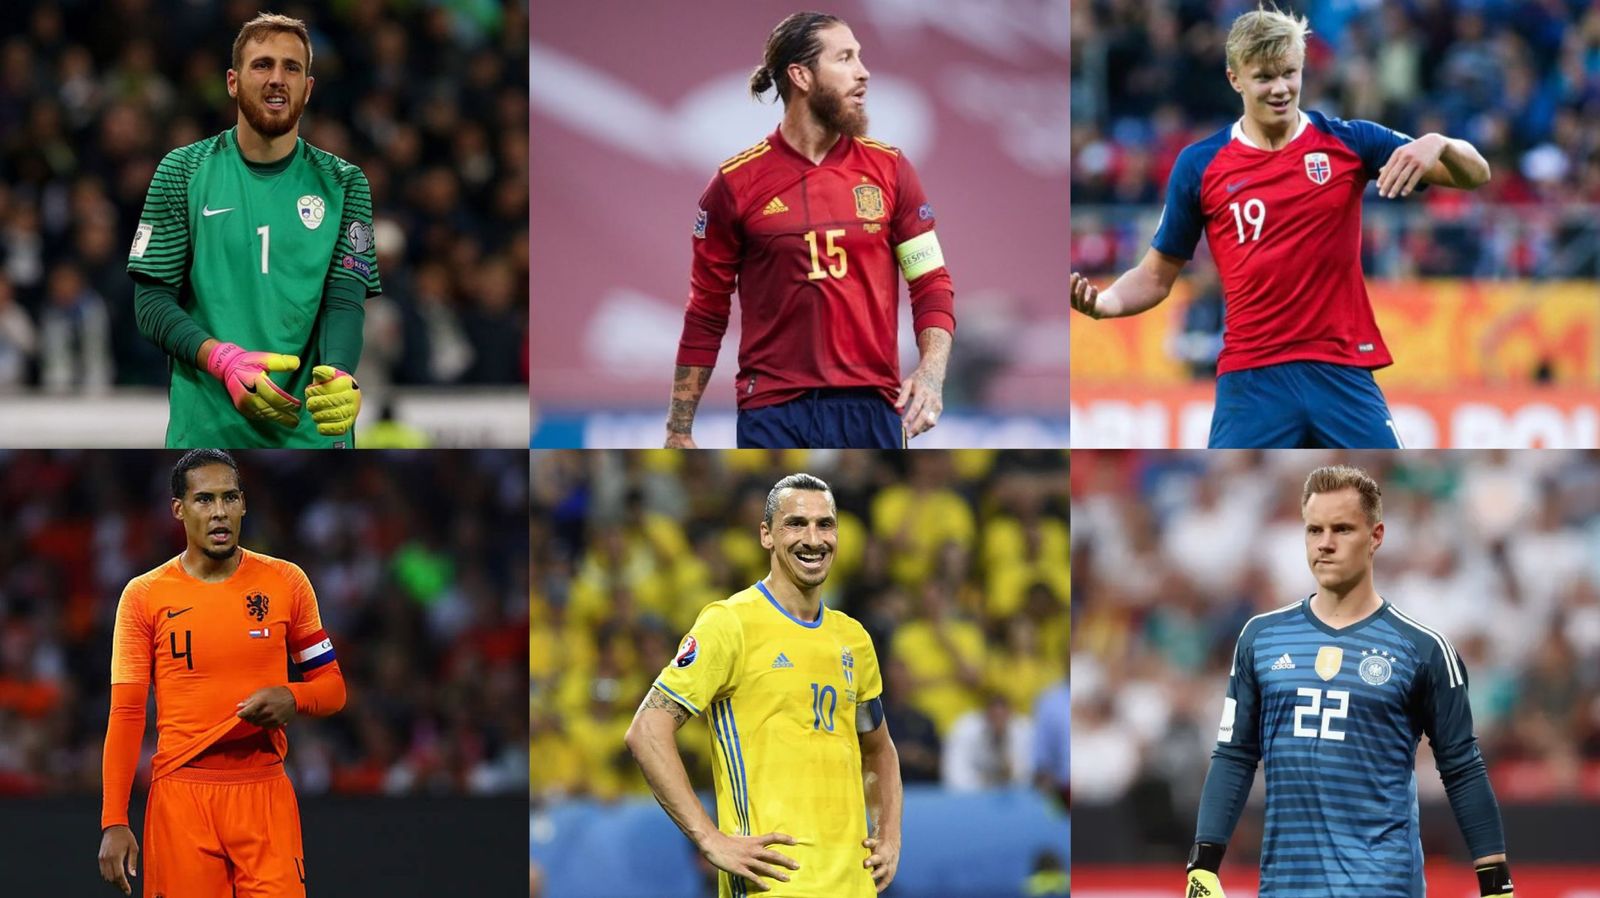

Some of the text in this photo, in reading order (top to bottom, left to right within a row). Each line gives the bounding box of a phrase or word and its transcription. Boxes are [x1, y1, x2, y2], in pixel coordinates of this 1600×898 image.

[1229, 198, 1267, 245] 19
[256, 224, 270, 275] 1
[804, 229, 848, 281] 15
[170, 630, 193, 671] 4
[1271, 663, 1296, 672] adidas
[810, 683, 837, 732] 10
[1294, 687, 1350, 741] 22
